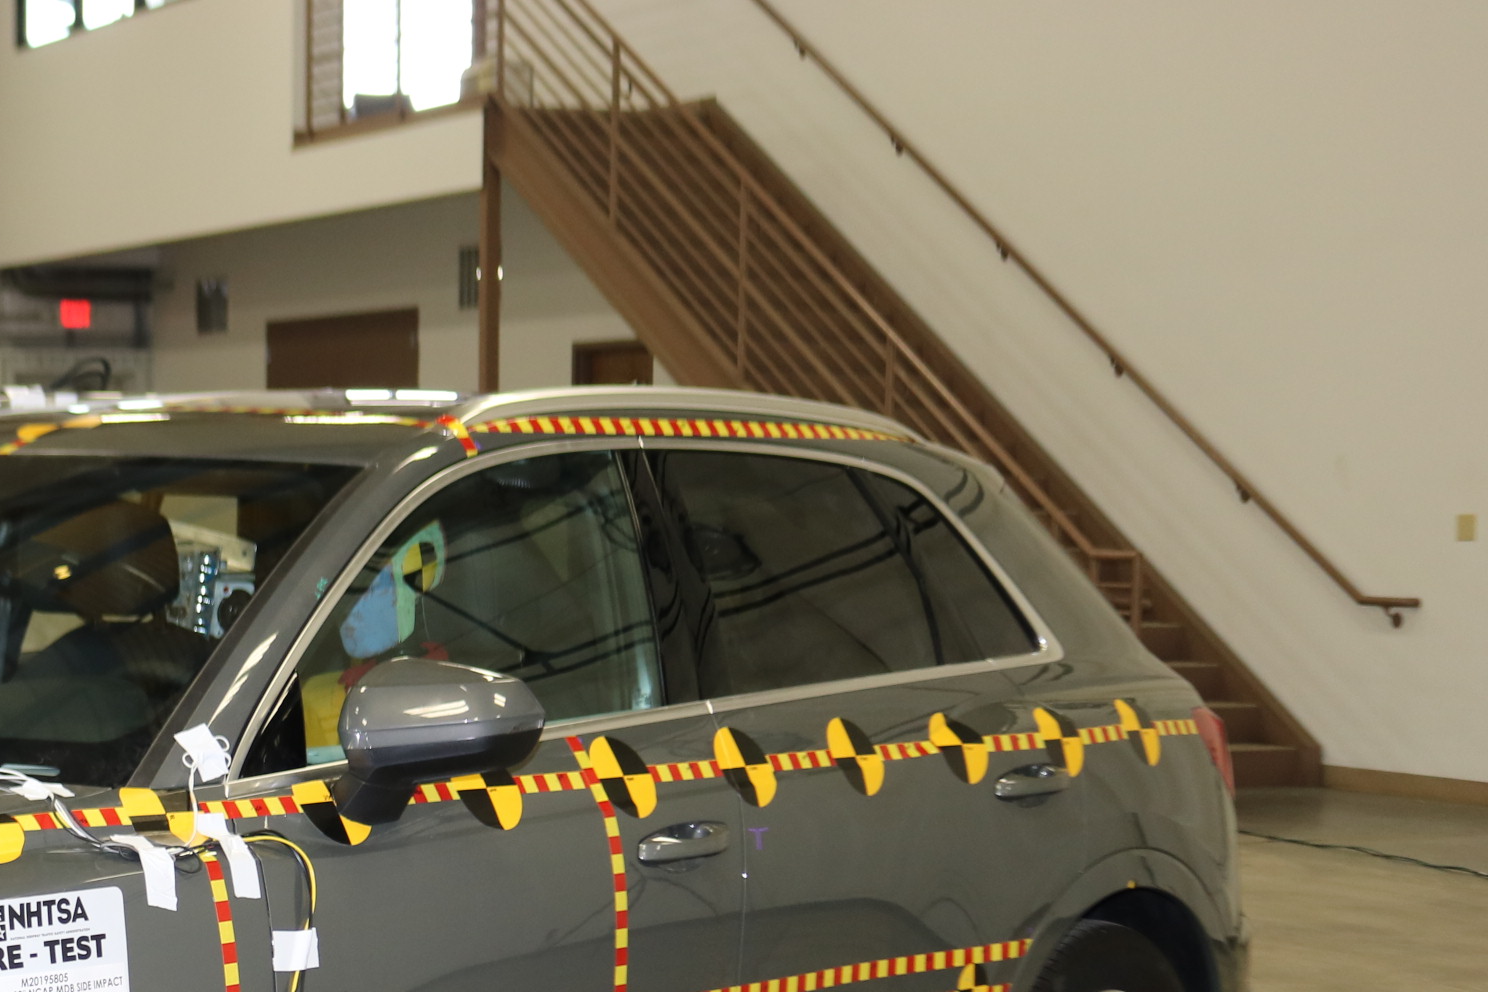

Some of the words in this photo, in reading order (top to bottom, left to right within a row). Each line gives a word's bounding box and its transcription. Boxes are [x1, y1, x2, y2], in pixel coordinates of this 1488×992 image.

[8, 896, 89, 931] NHTSA
[44, 933, 106, 964] TEST
[21, 972, 69, 988] M20195805
[76, 980, 92, 992] SIDE
[93, 976, 123, 990] IMPACT
